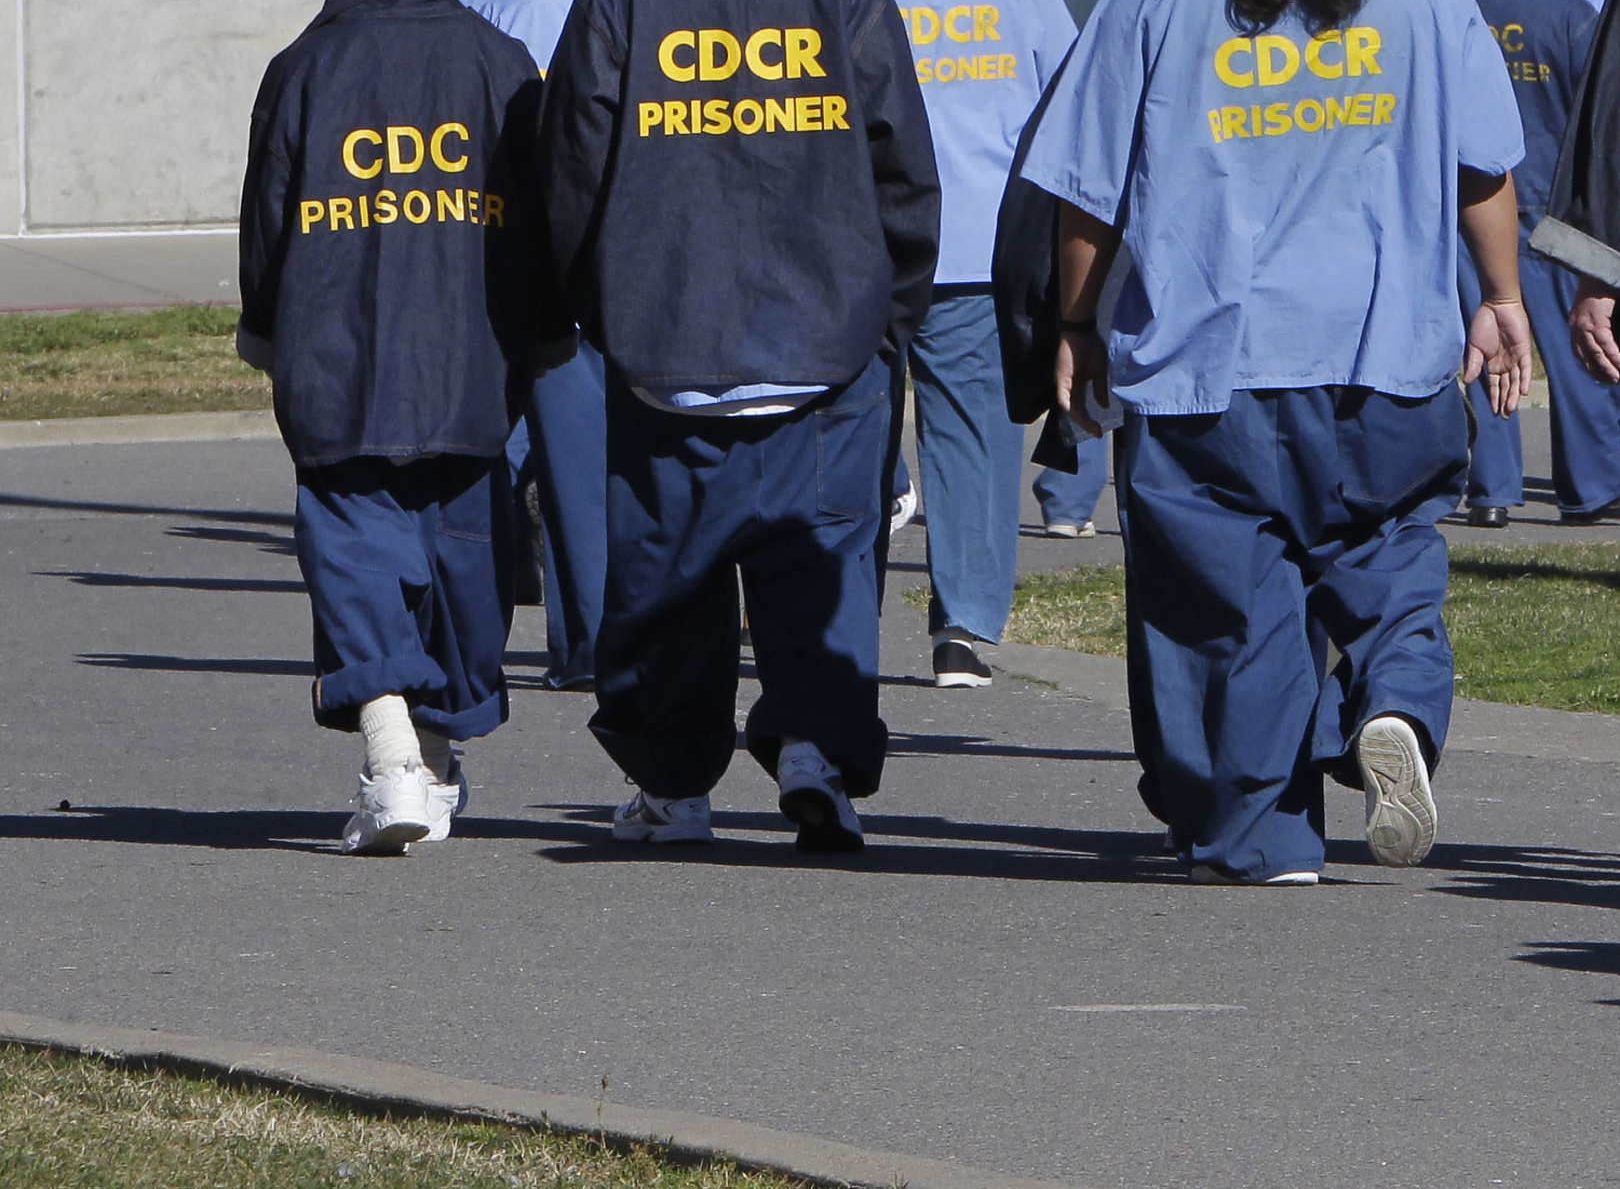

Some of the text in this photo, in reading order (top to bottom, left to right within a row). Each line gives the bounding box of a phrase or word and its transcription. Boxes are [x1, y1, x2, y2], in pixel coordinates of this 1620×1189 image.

[657, 27, 828, 83] CDCR
[1213, 26, 1383, 89] CDCR
[637, 95, 852, 138] PRISONER
[1206, 92, 1398, 144] PRISONER
[341, 121, 470, 181] CDC
[299, 188, 505, 235] PRISONER
